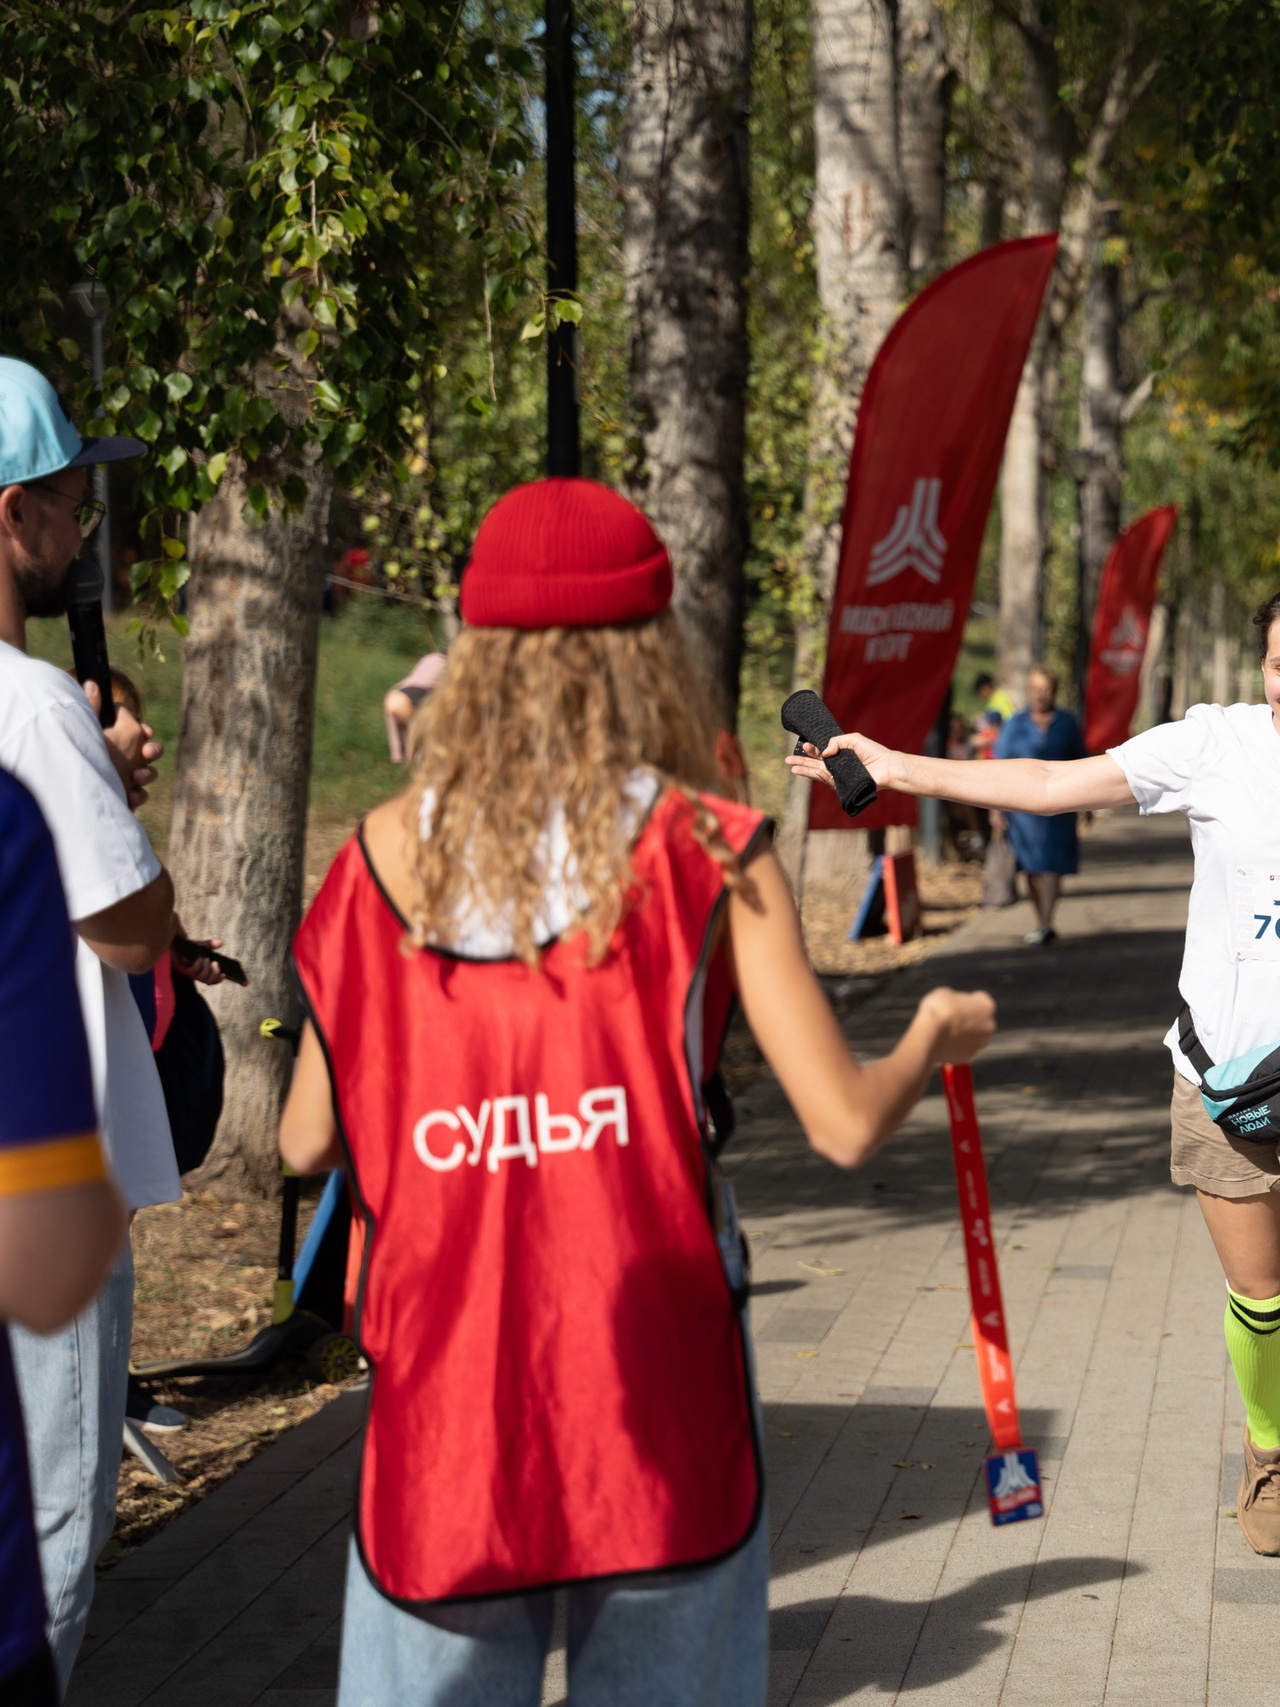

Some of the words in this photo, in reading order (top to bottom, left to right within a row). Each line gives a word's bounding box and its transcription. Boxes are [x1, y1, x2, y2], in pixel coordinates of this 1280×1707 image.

[1231, 1104, 1271, 1126] НОВЫЕ
[1239, 1116, 1271, 1133] ЛЮДИ
[413, 1084, 629, 1174] СУДЬЯ
